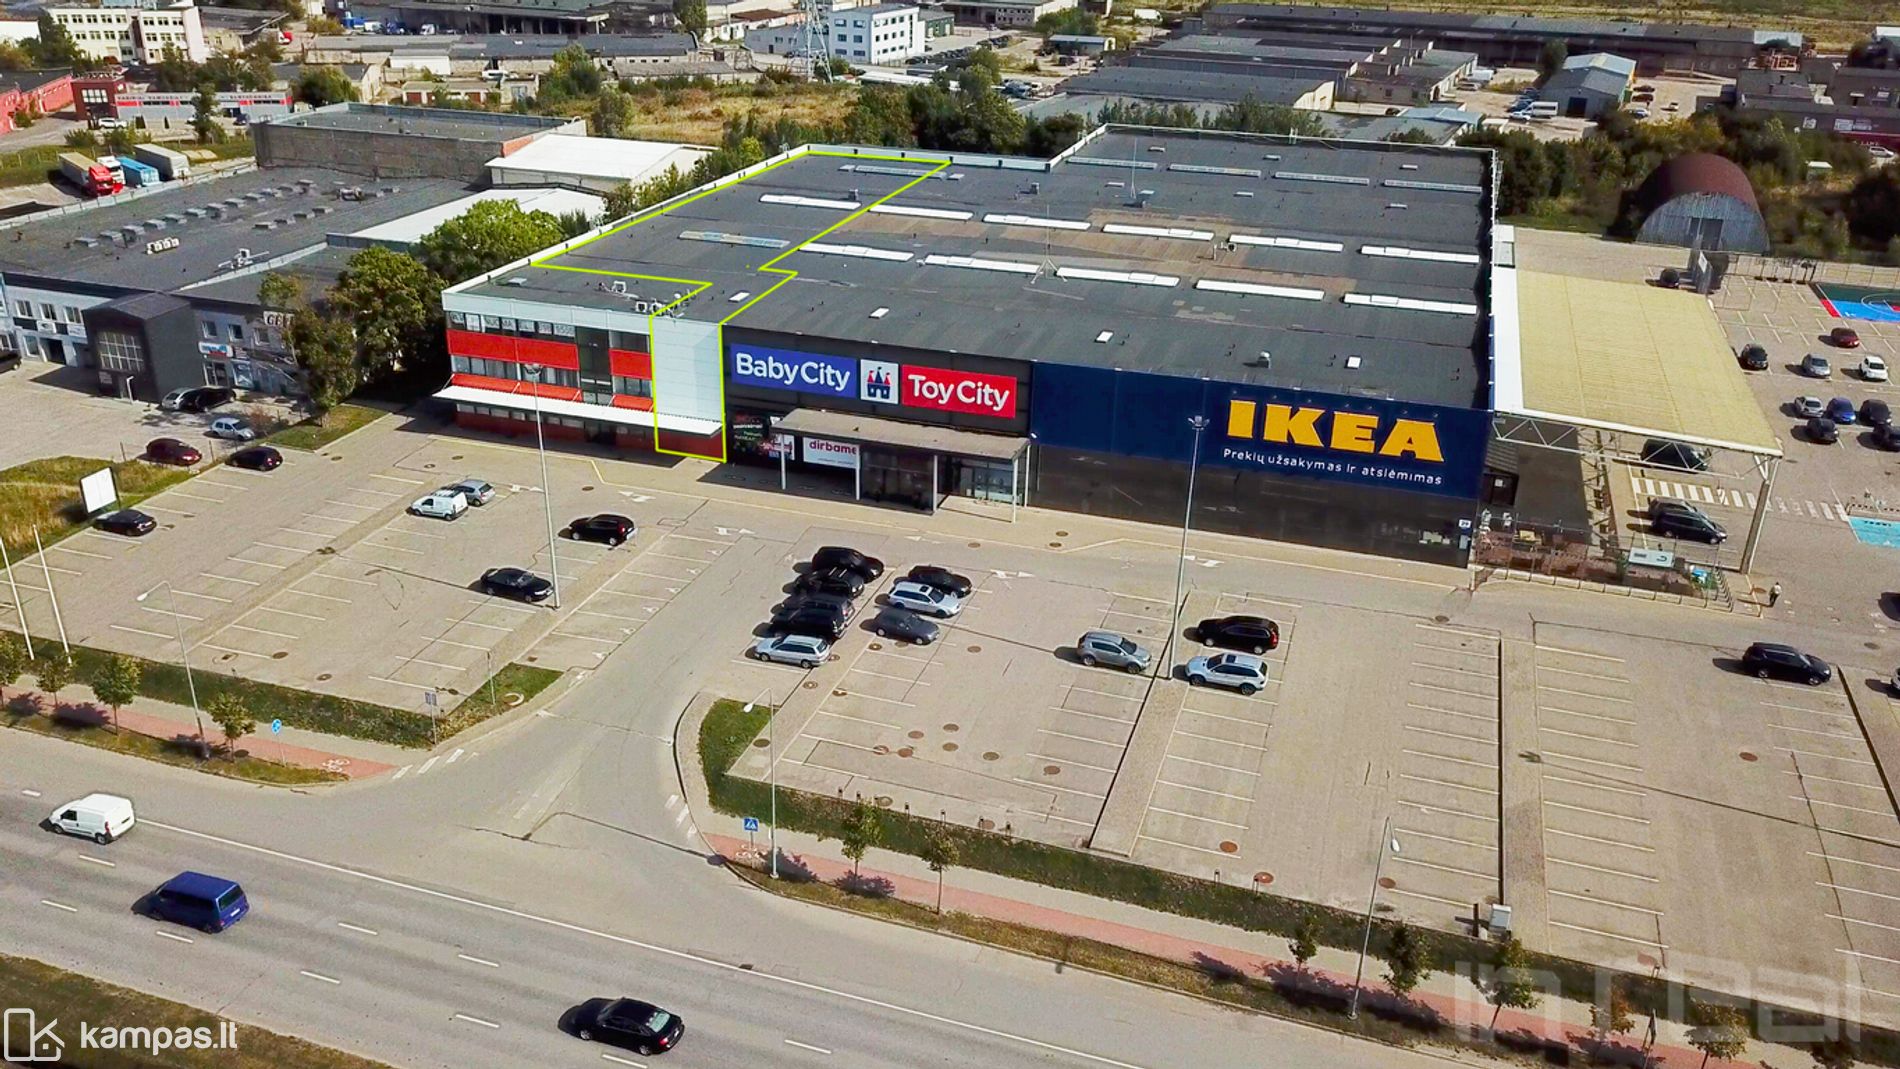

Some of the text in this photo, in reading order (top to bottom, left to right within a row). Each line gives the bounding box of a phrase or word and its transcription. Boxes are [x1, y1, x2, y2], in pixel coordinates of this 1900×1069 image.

[1227, 399, 1444, 463] IKEA
[1223, 448, 1442, 485] Prekių užsakymas ir atsiėmimas
